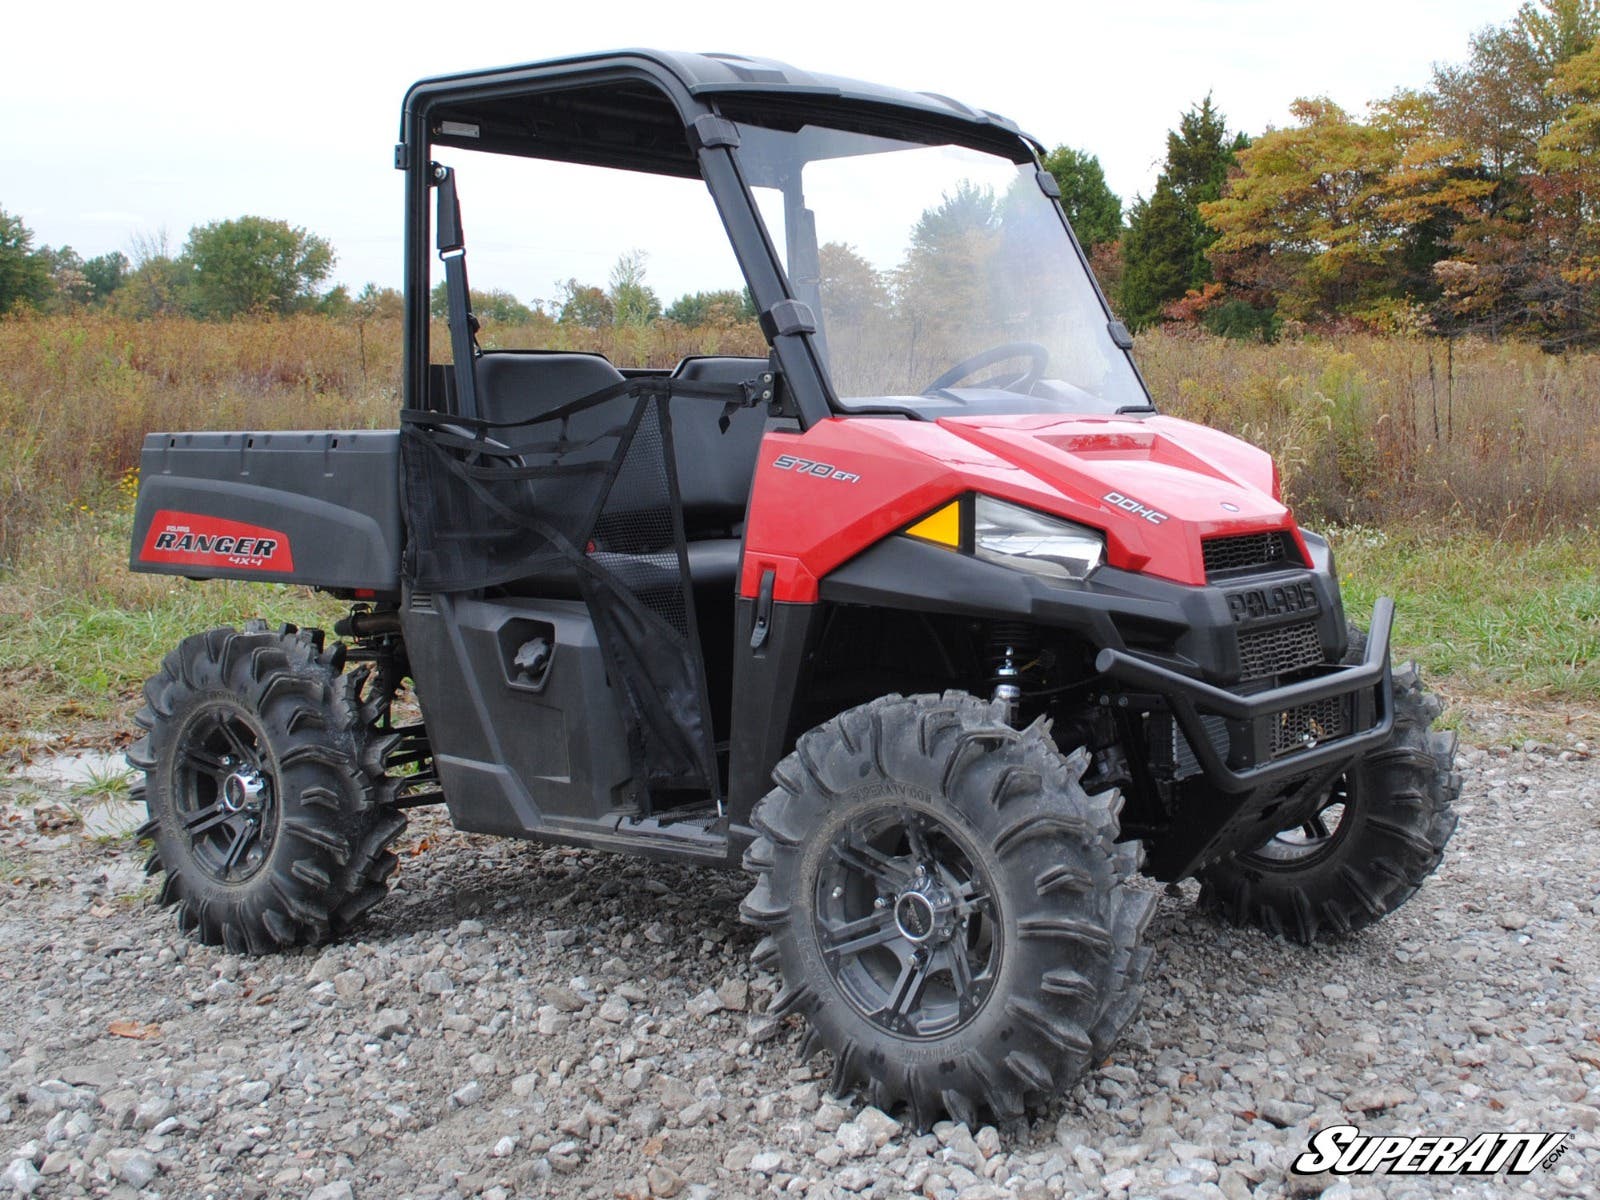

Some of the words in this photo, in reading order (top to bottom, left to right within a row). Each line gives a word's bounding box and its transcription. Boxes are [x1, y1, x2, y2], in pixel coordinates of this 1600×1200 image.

[772, 454, 835, 479] 570
[1102, 491, 1170, 525] DOHC
[154, 531, 277, 559] RANGER
[1224, 582, 1318, 622] POLARIS
